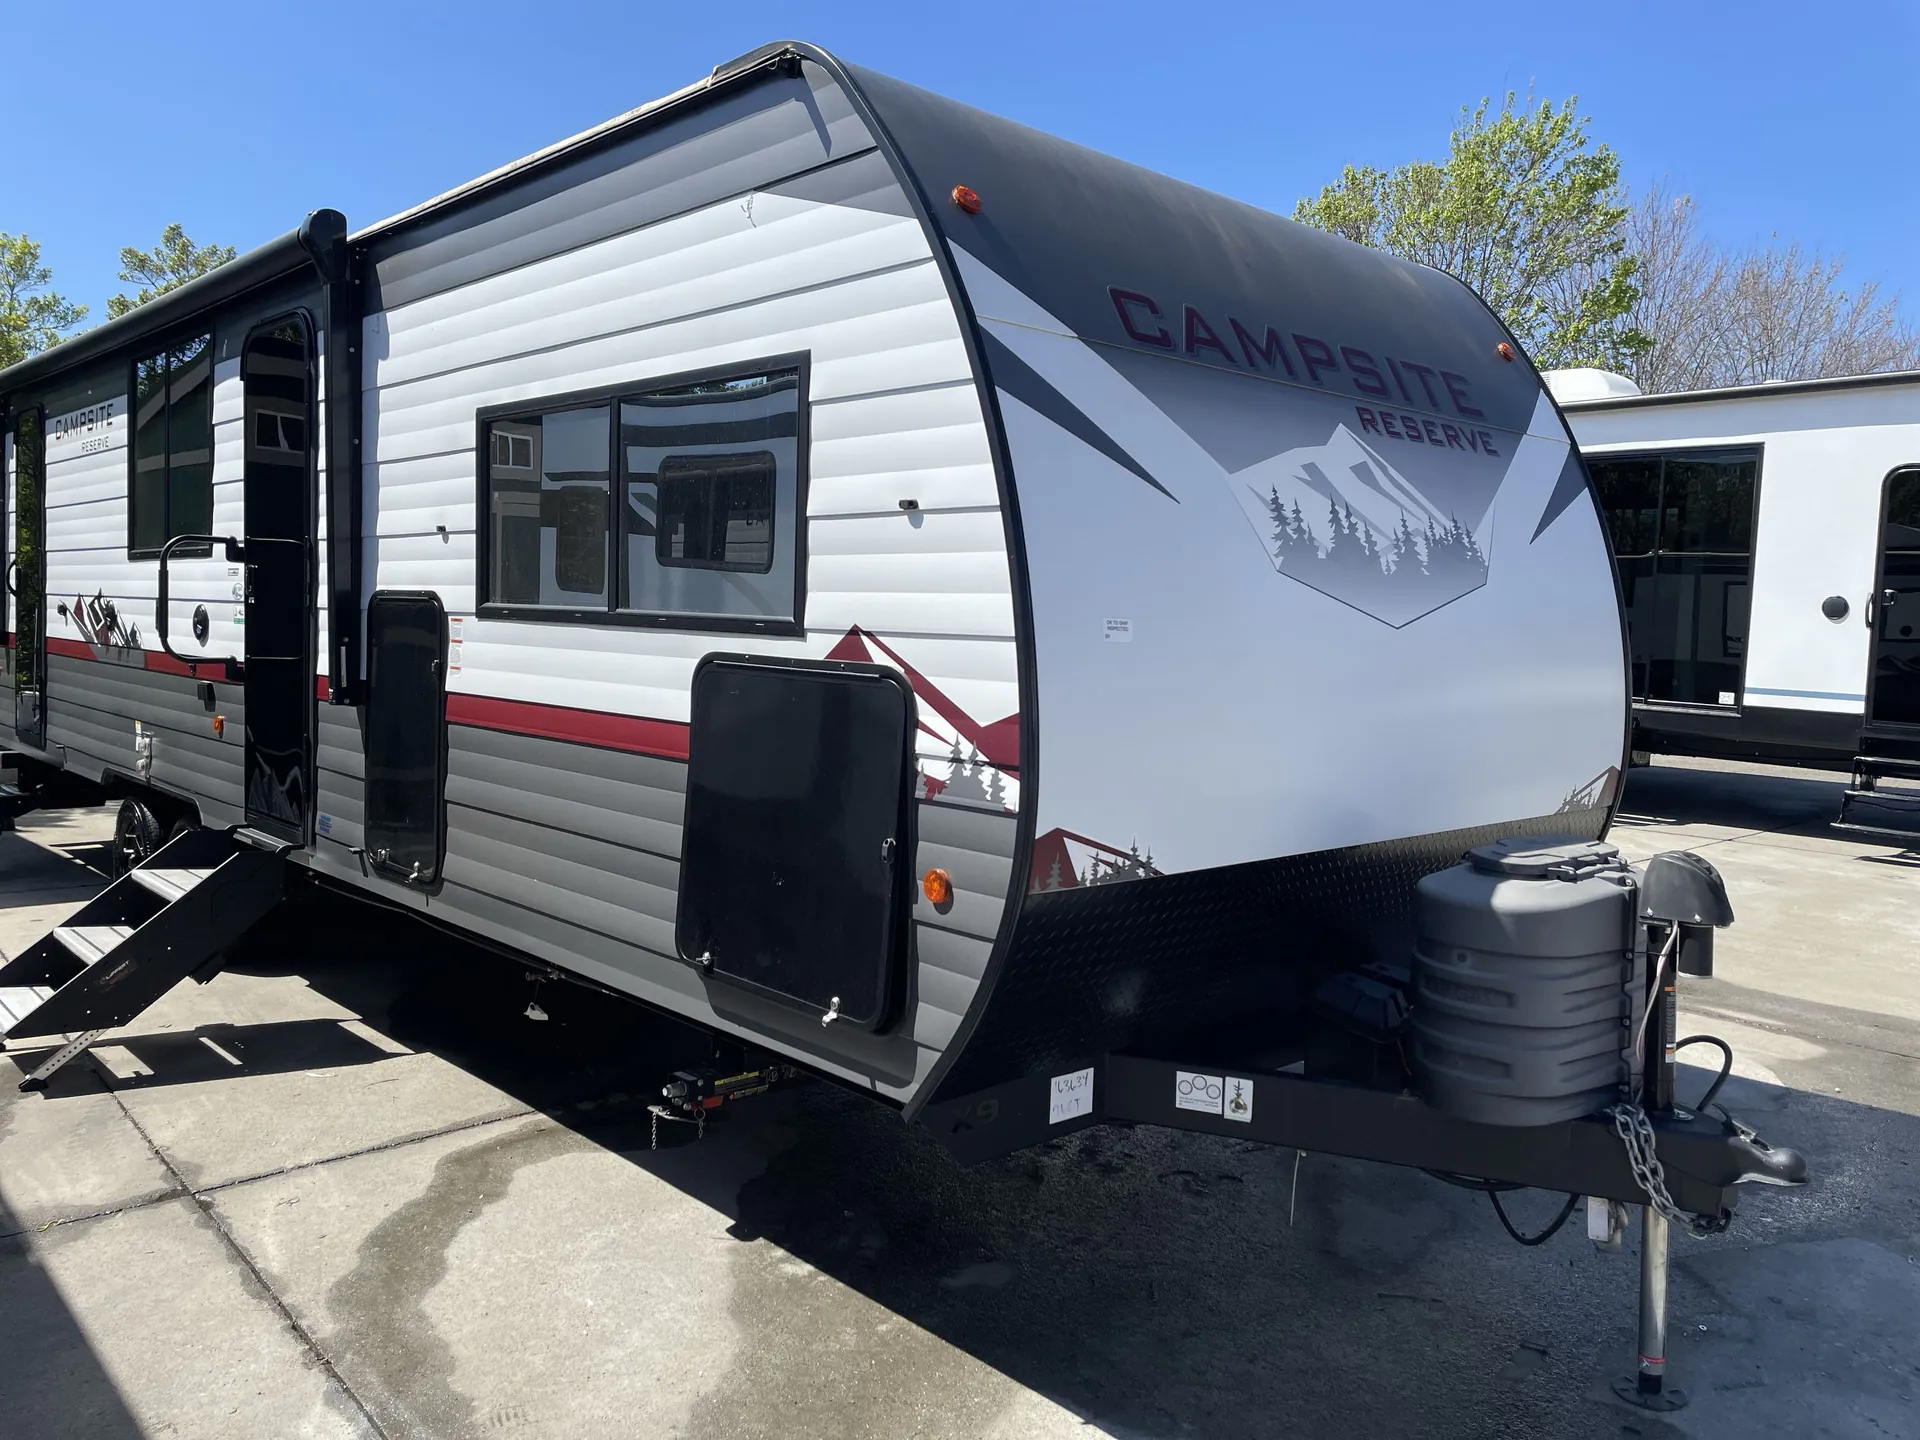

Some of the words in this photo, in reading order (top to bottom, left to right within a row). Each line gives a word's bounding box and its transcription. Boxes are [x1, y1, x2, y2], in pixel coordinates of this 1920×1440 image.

[1107, 284, 1486, 419] CAMPSITE
[55, 403, 114, 440] CAMPSITE
[1355, 406, 1499, 456] RESERVE
[81, 436, 109, 453] RESERVE
